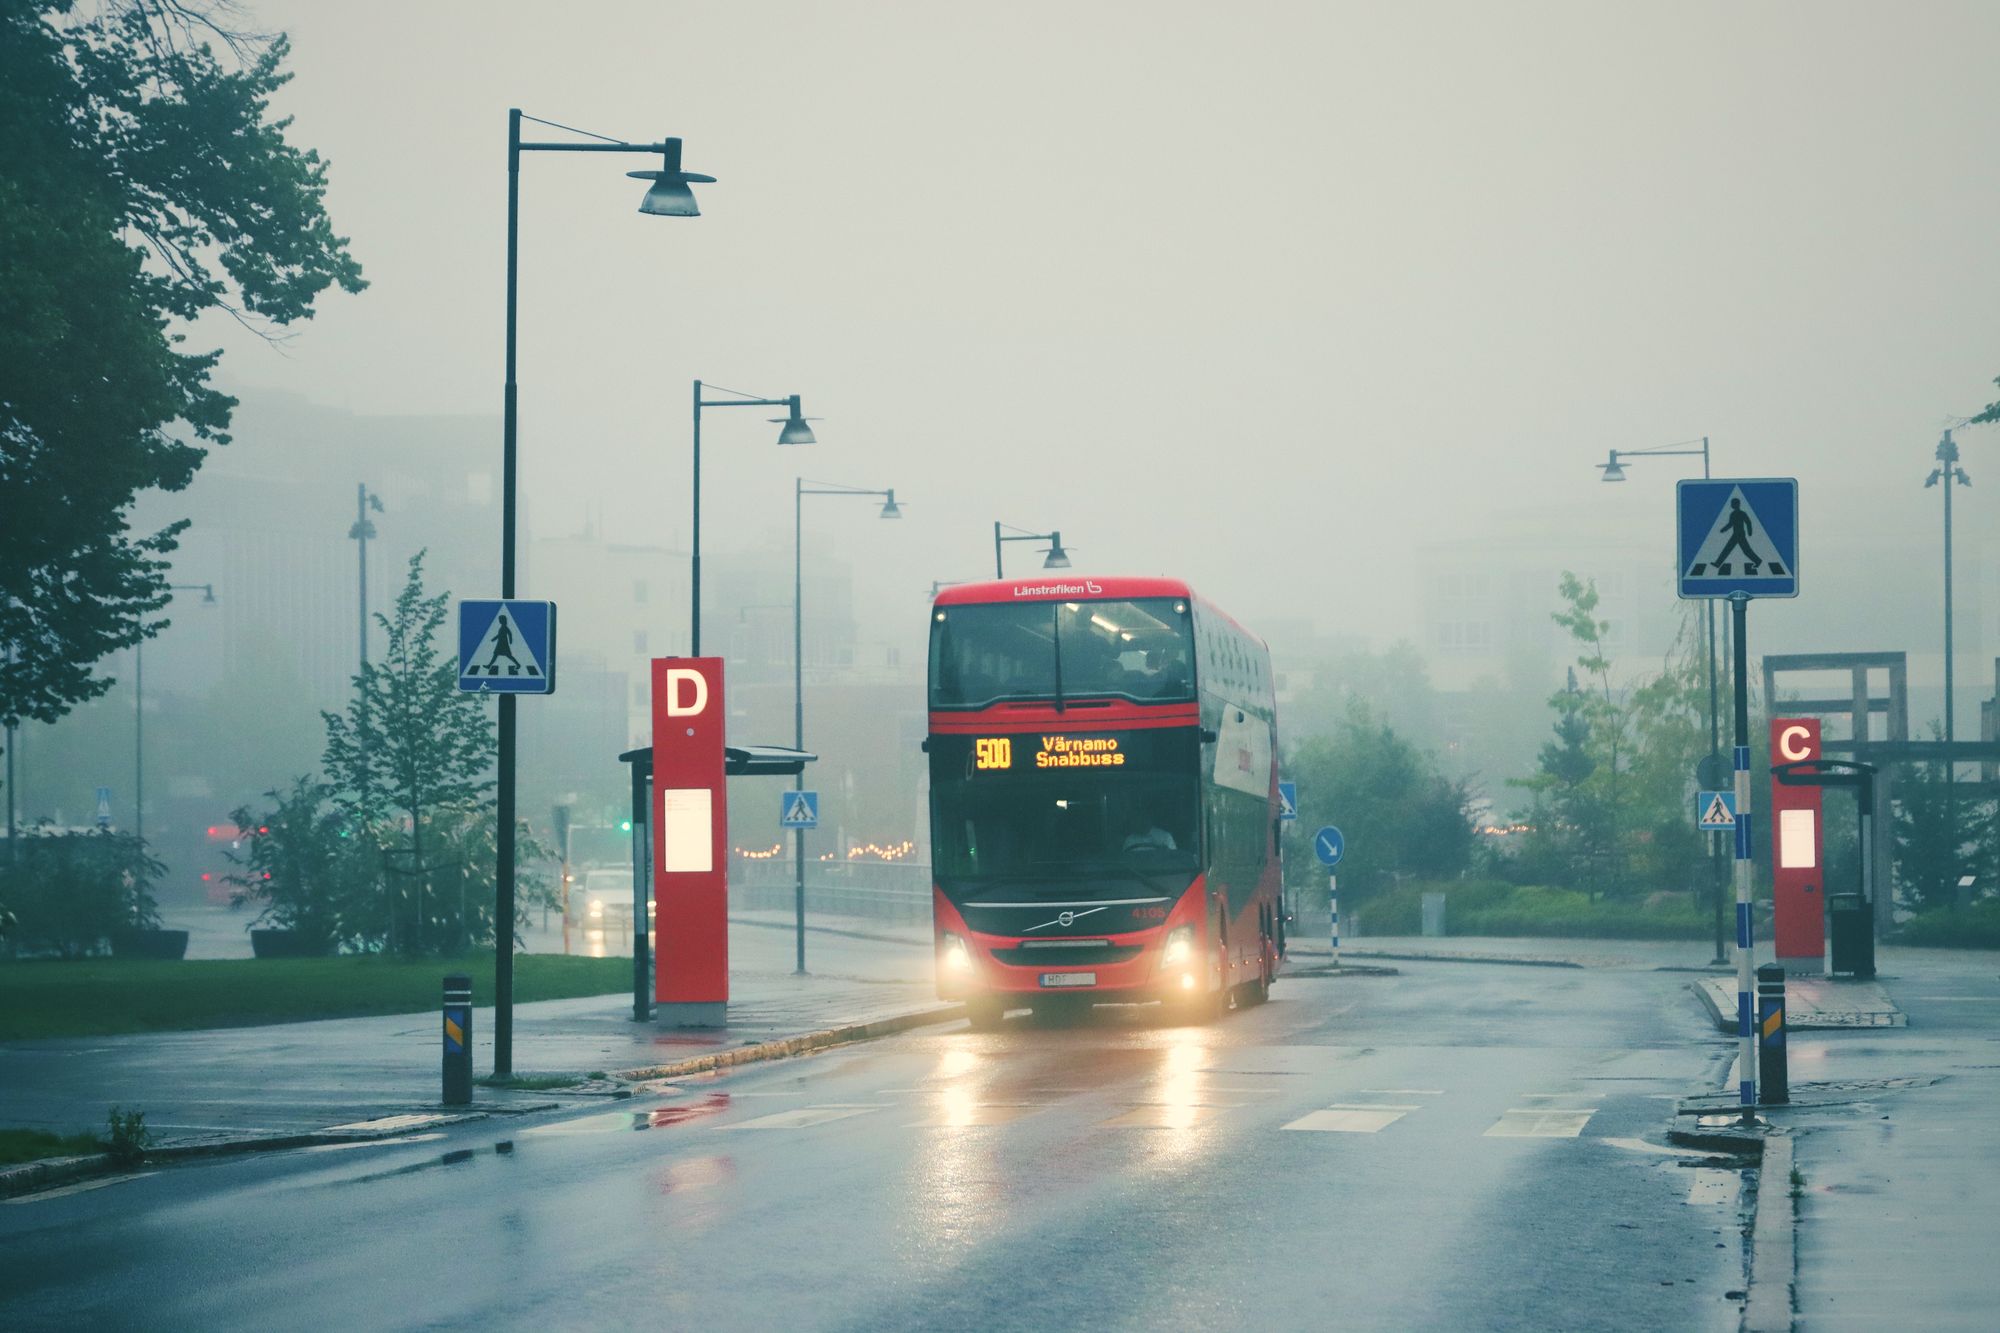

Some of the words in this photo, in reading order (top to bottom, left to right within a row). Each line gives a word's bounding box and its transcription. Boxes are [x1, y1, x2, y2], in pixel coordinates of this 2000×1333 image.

[1014, 584, 1084, 596] Länstrafiken
[666, 668, 708, 717] D
[976, 738, 1011, 768] 500
[1042, 736, 1118, 751] Värnamo
[1780, 725, 1811, 760] C
[1036, 751, 1125, 767] Snabbuss
